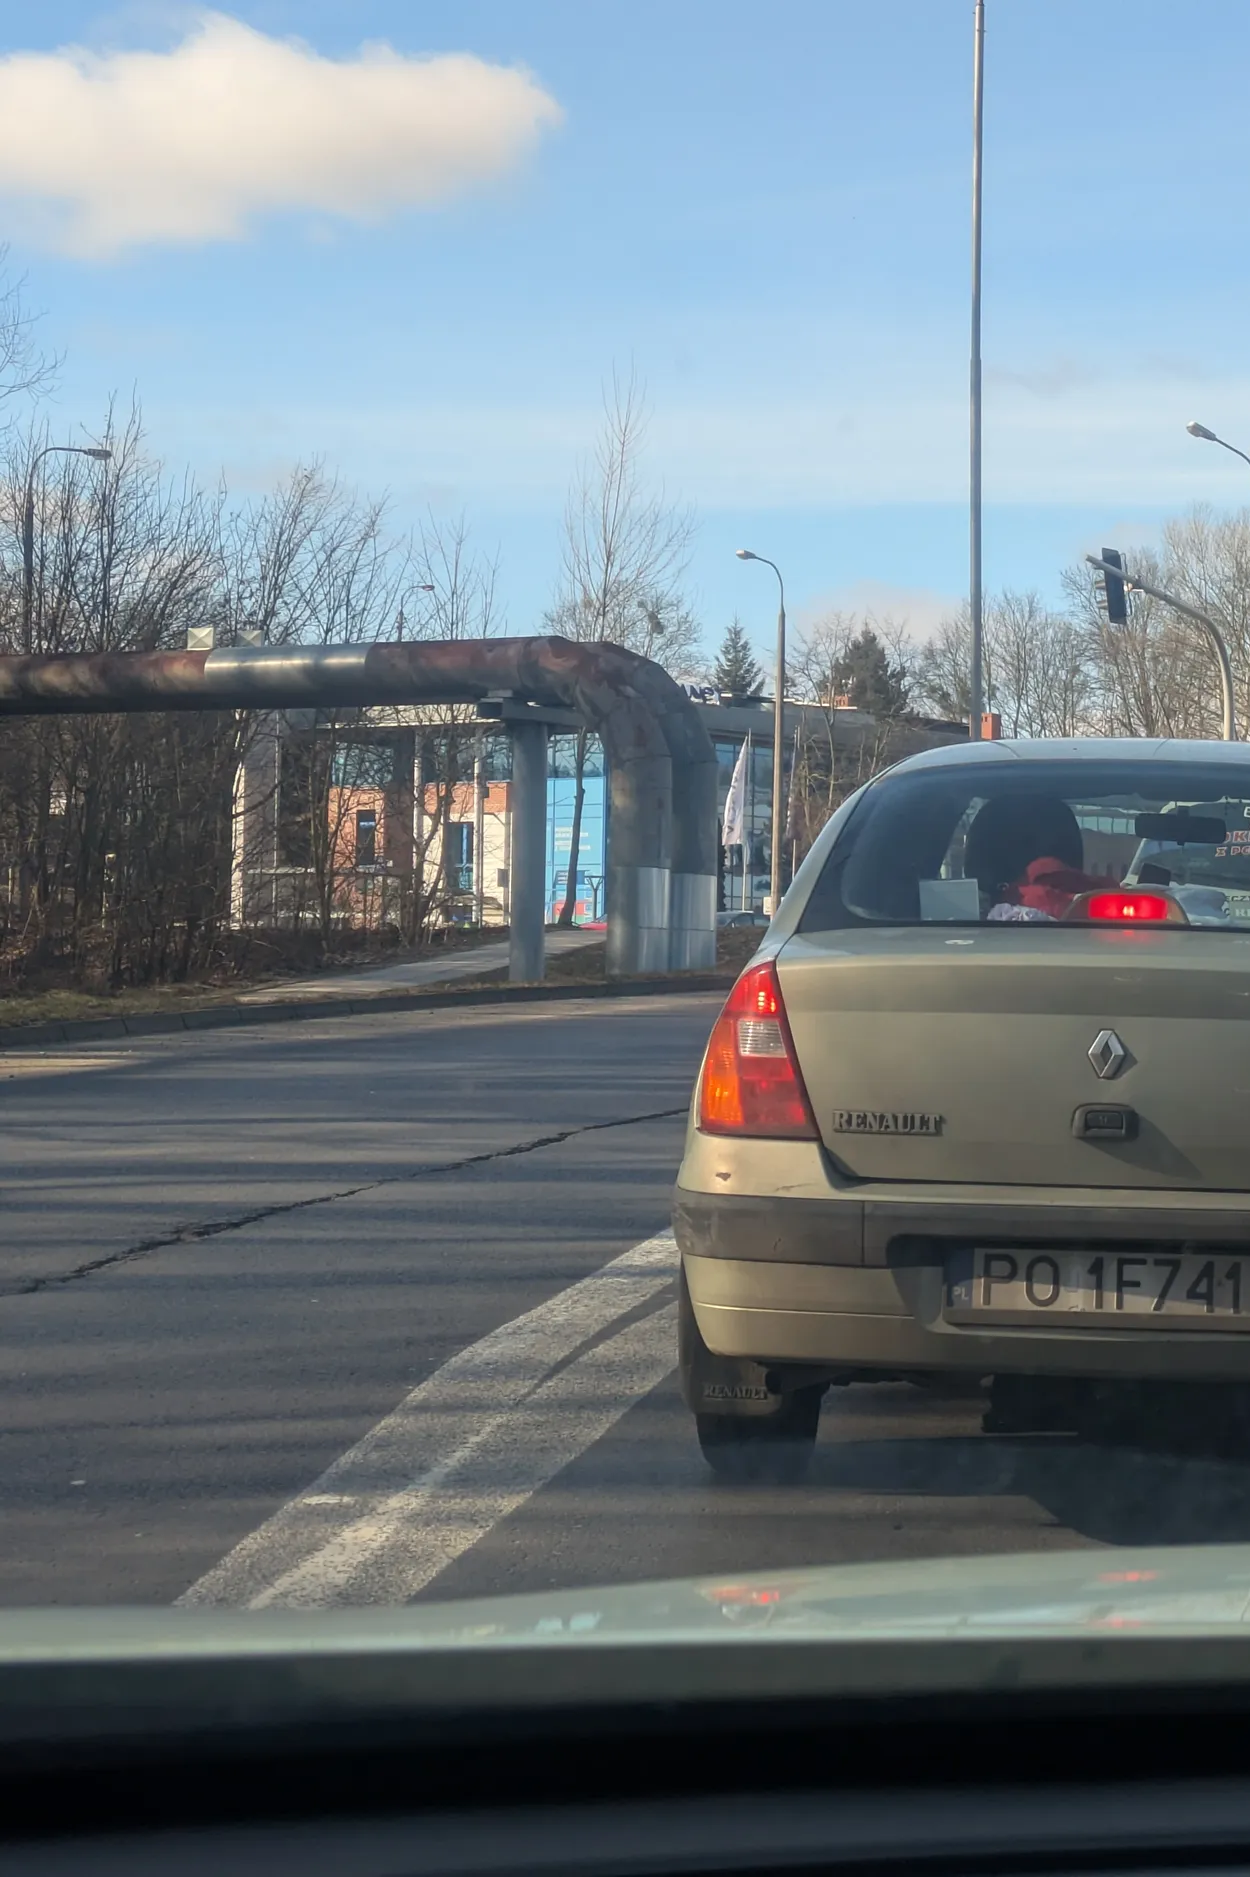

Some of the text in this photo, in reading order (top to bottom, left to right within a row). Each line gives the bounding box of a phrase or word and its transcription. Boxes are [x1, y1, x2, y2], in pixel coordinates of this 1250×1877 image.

[832, 1110, 940, 1132] RENAULT
[982, 1252, 1243, 1315] PO 1F741
